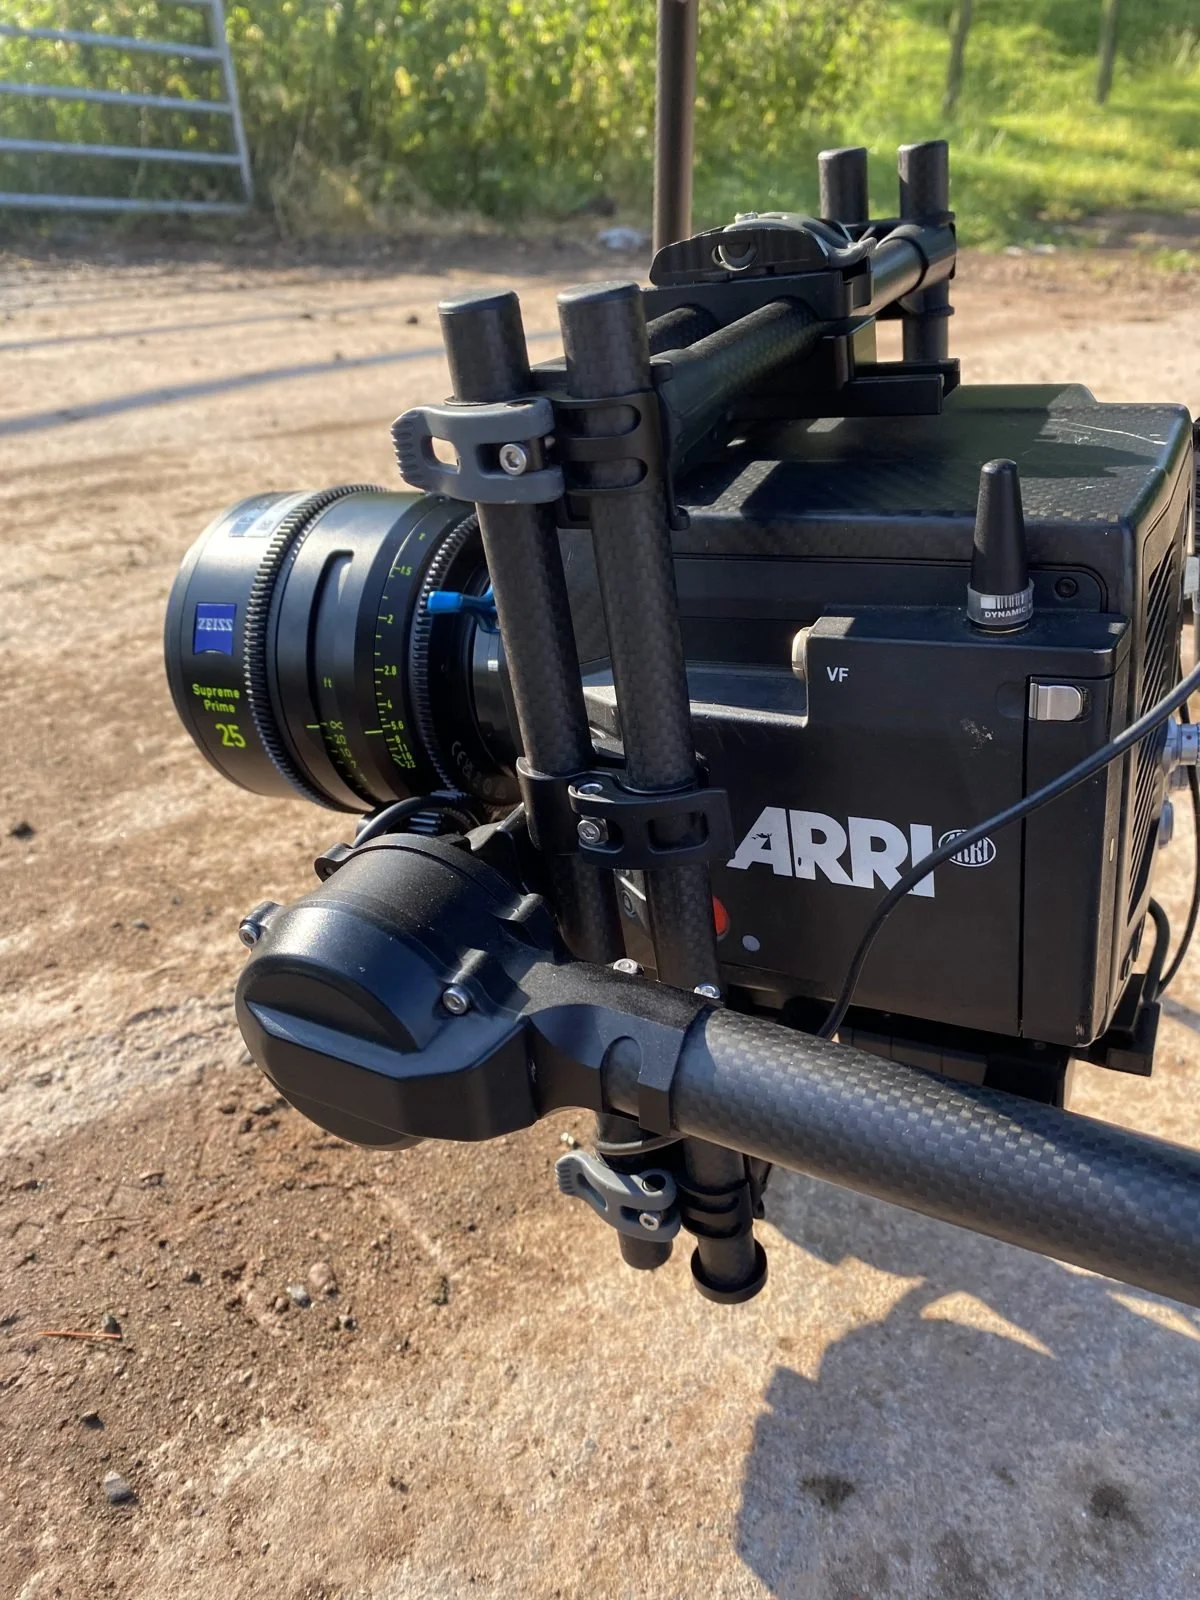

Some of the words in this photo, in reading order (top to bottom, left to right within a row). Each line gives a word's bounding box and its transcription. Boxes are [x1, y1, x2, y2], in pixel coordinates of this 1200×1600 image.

[985, 606, 1026, 618] DYNAMIC
[197, 617, 233, 632] ZEISS
[387, 614, 394, 625] 2
[384, 665, 397, 675] 2.8
[826, 666, 850, 683] VF
[192, 683, 240, 699] Supreme
[204, 699, 236, 713] Prime
[387, 699, 393, 709] 4
[390, 720, 404, 730] 5.6
[215, 723, 246, 748] 25
[725, 806, 935, 898] ARRI
[944, 832, 989, 863] RRI
